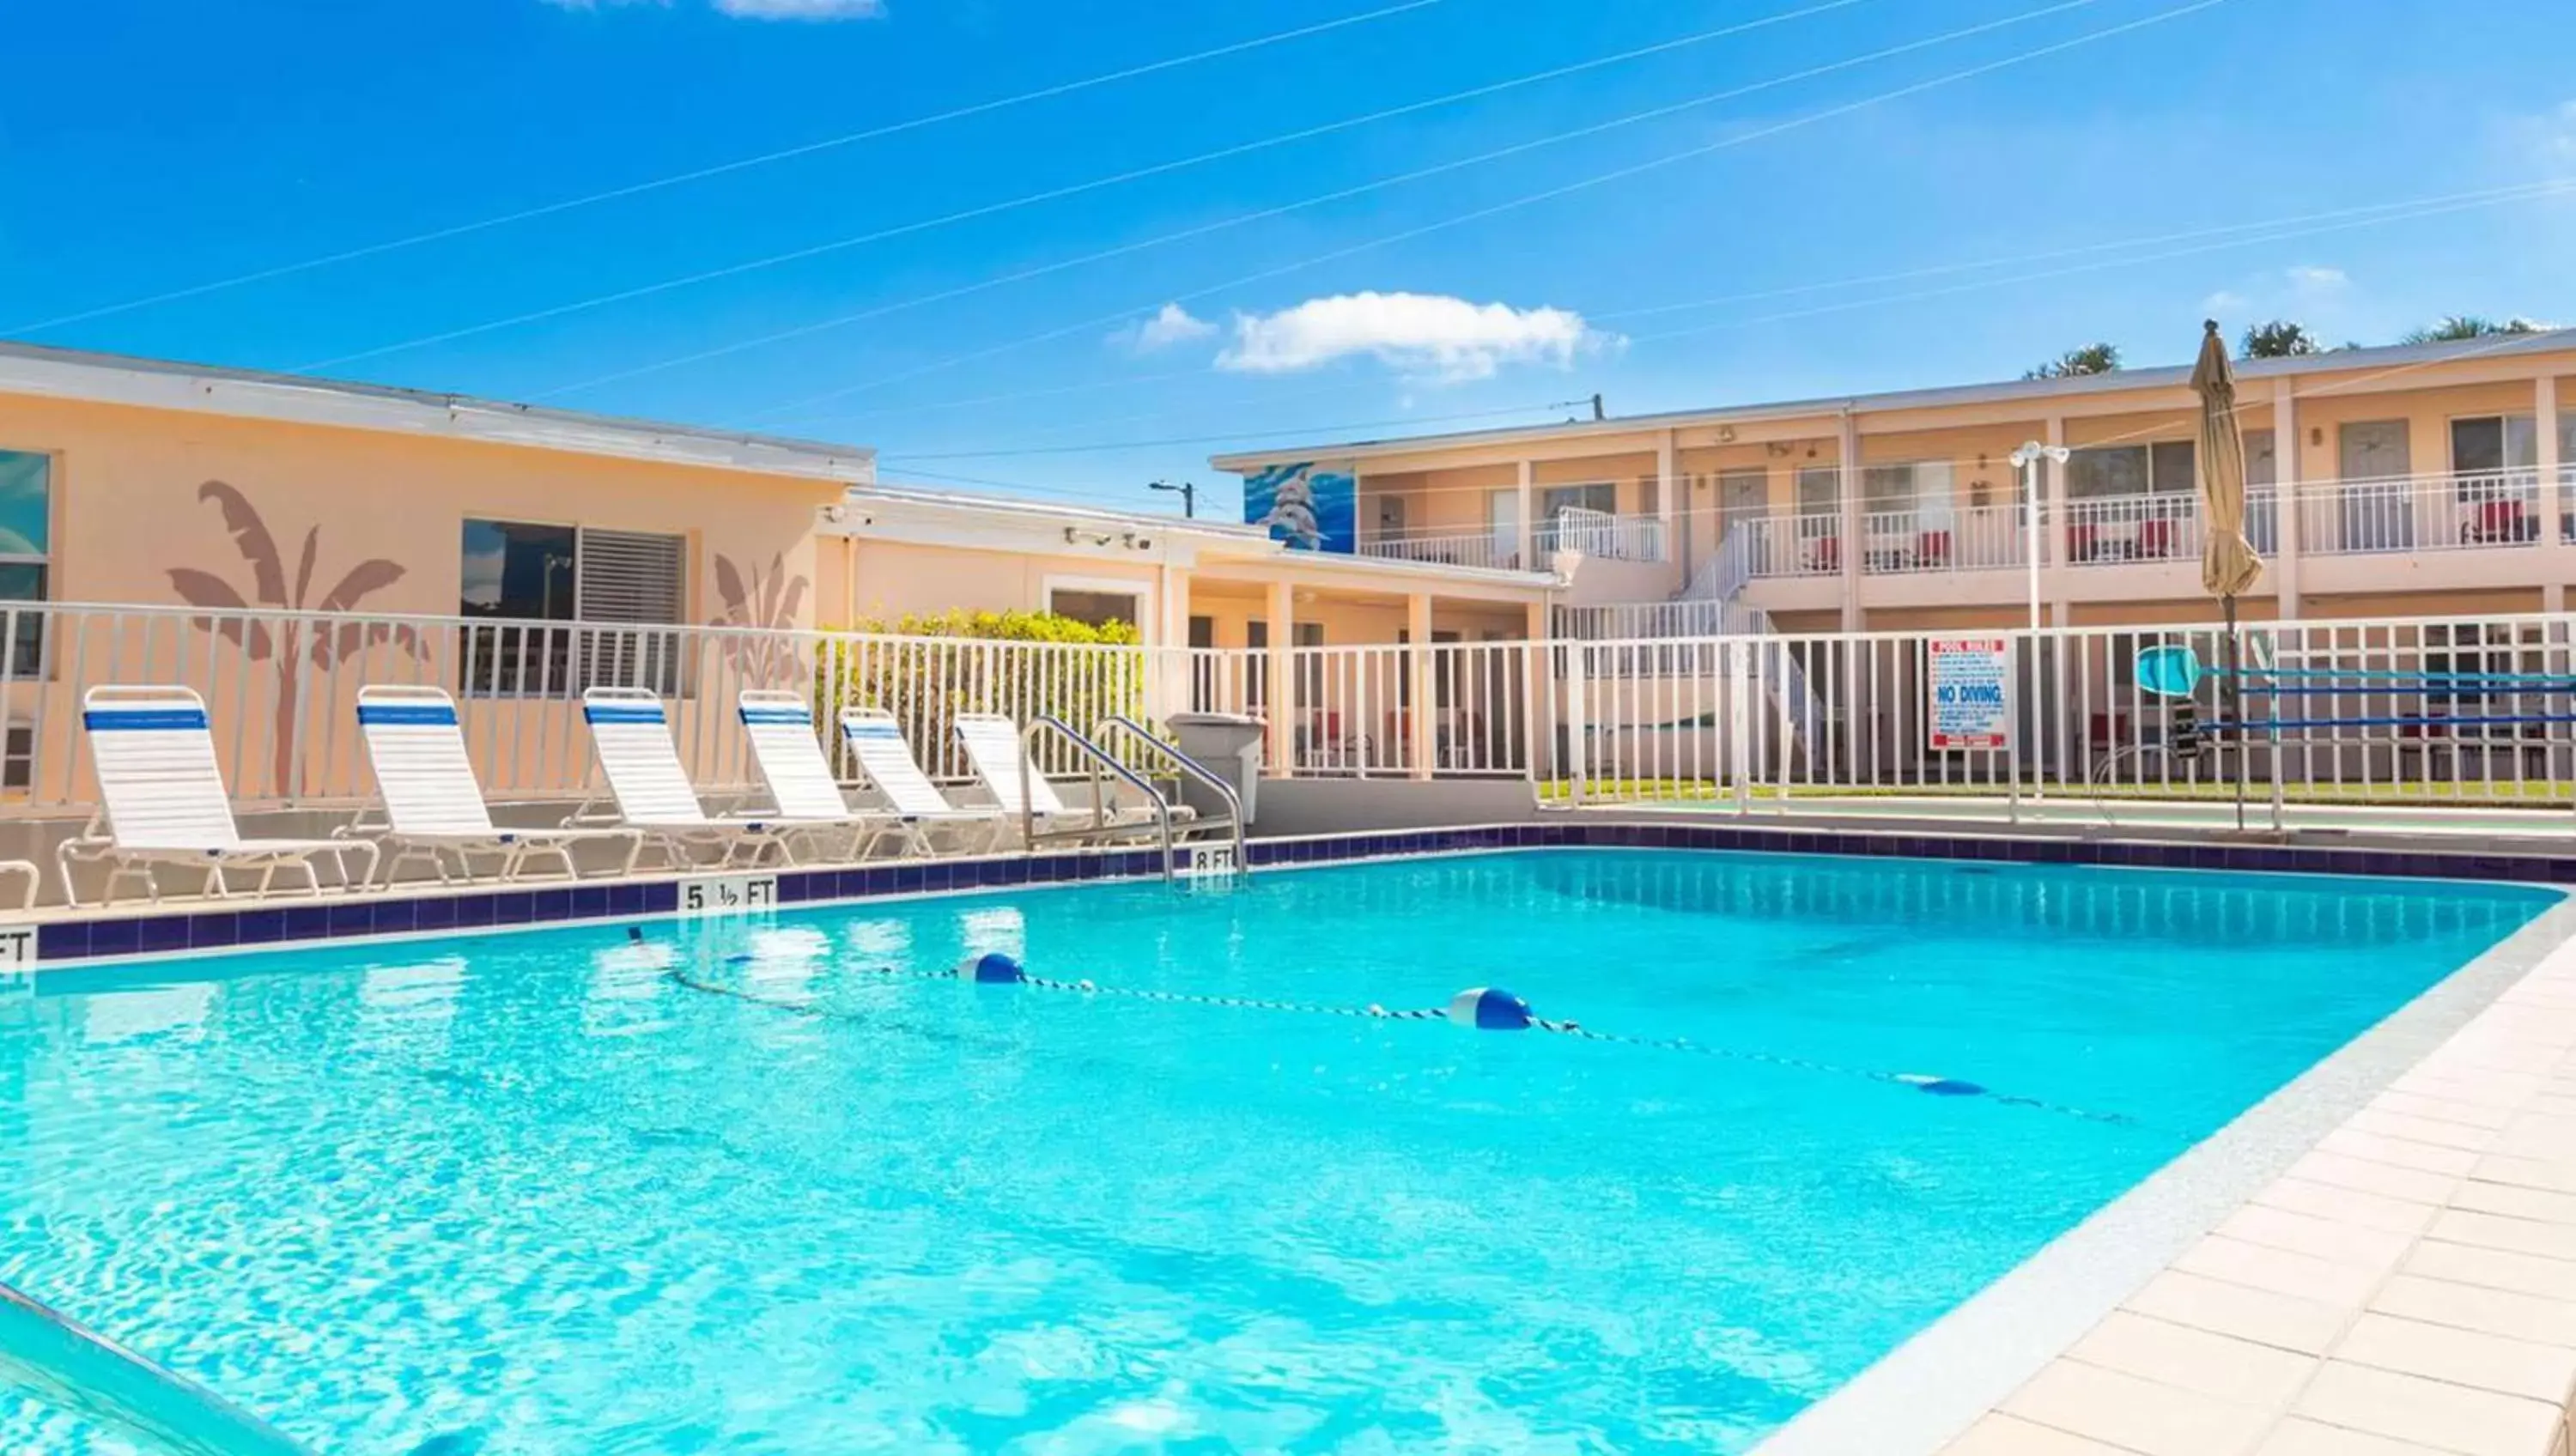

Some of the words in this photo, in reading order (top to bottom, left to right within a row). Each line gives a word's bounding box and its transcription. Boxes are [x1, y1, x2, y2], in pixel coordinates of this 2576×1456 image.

[1938, 685, 1955, 702] NO
[1197, 851, 1206, 871] 8
[1213, 849, 1230, 870] FT
[688, 884, 703, 909] 5
[747, 879, 774, 905] FT
